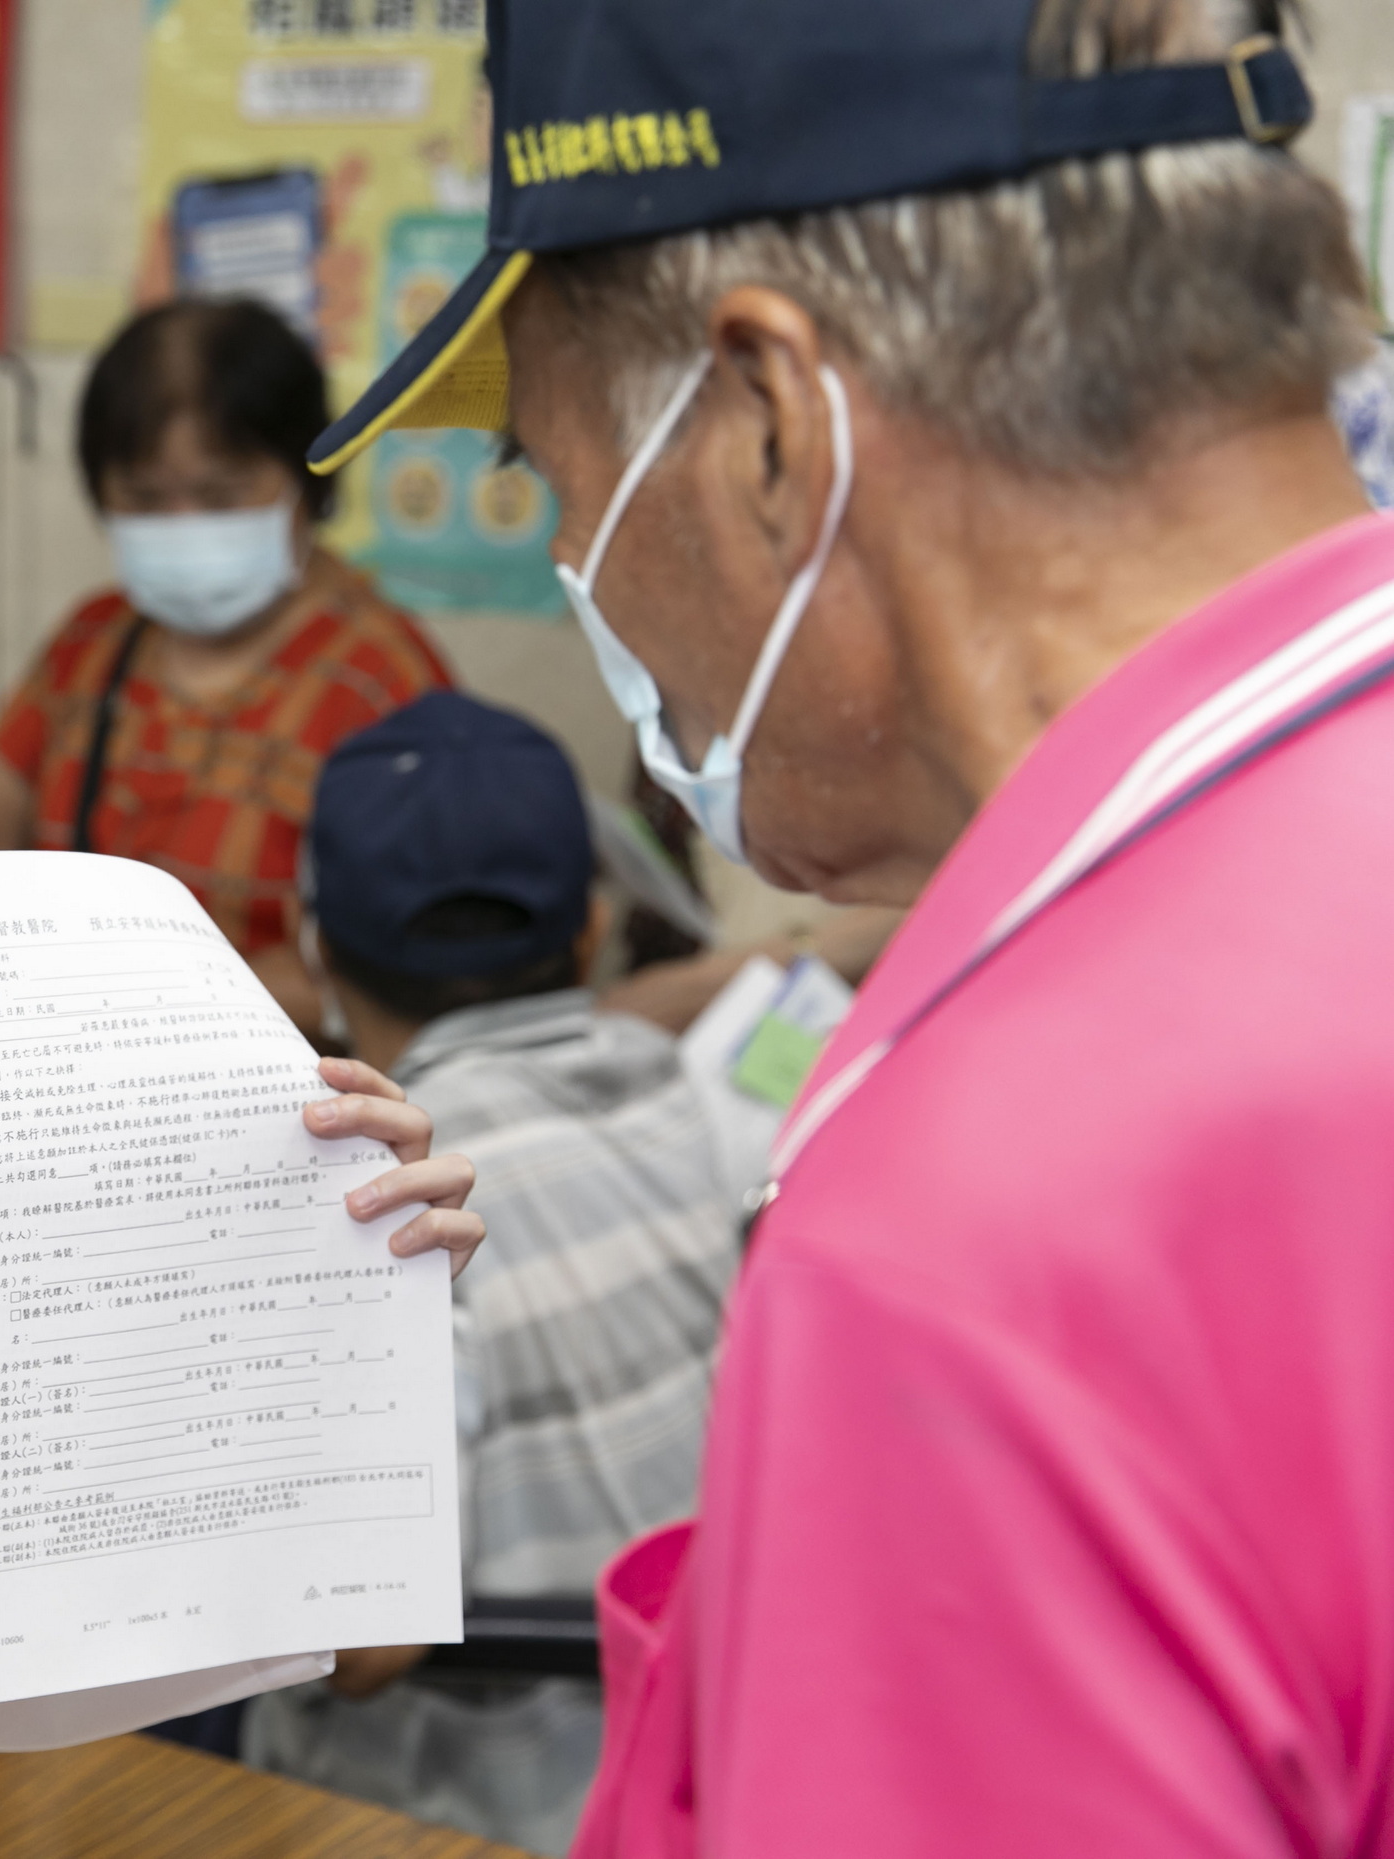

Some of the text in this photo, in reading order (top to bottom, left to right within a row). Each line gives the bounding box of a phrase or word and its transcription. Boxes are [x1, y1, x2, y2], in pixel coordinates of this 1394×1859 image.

[208, 1167, 218, 1178] 年
[242, 1164, 251, 1175] 月
[306, 1195, 315, 1206] 年
[309, 1295, 318, 1305] 年
[344, 1292, 353, 1303] 月
[311, 1353, 319, 1364] 年
[347, 1351, 355, 1362] 月
